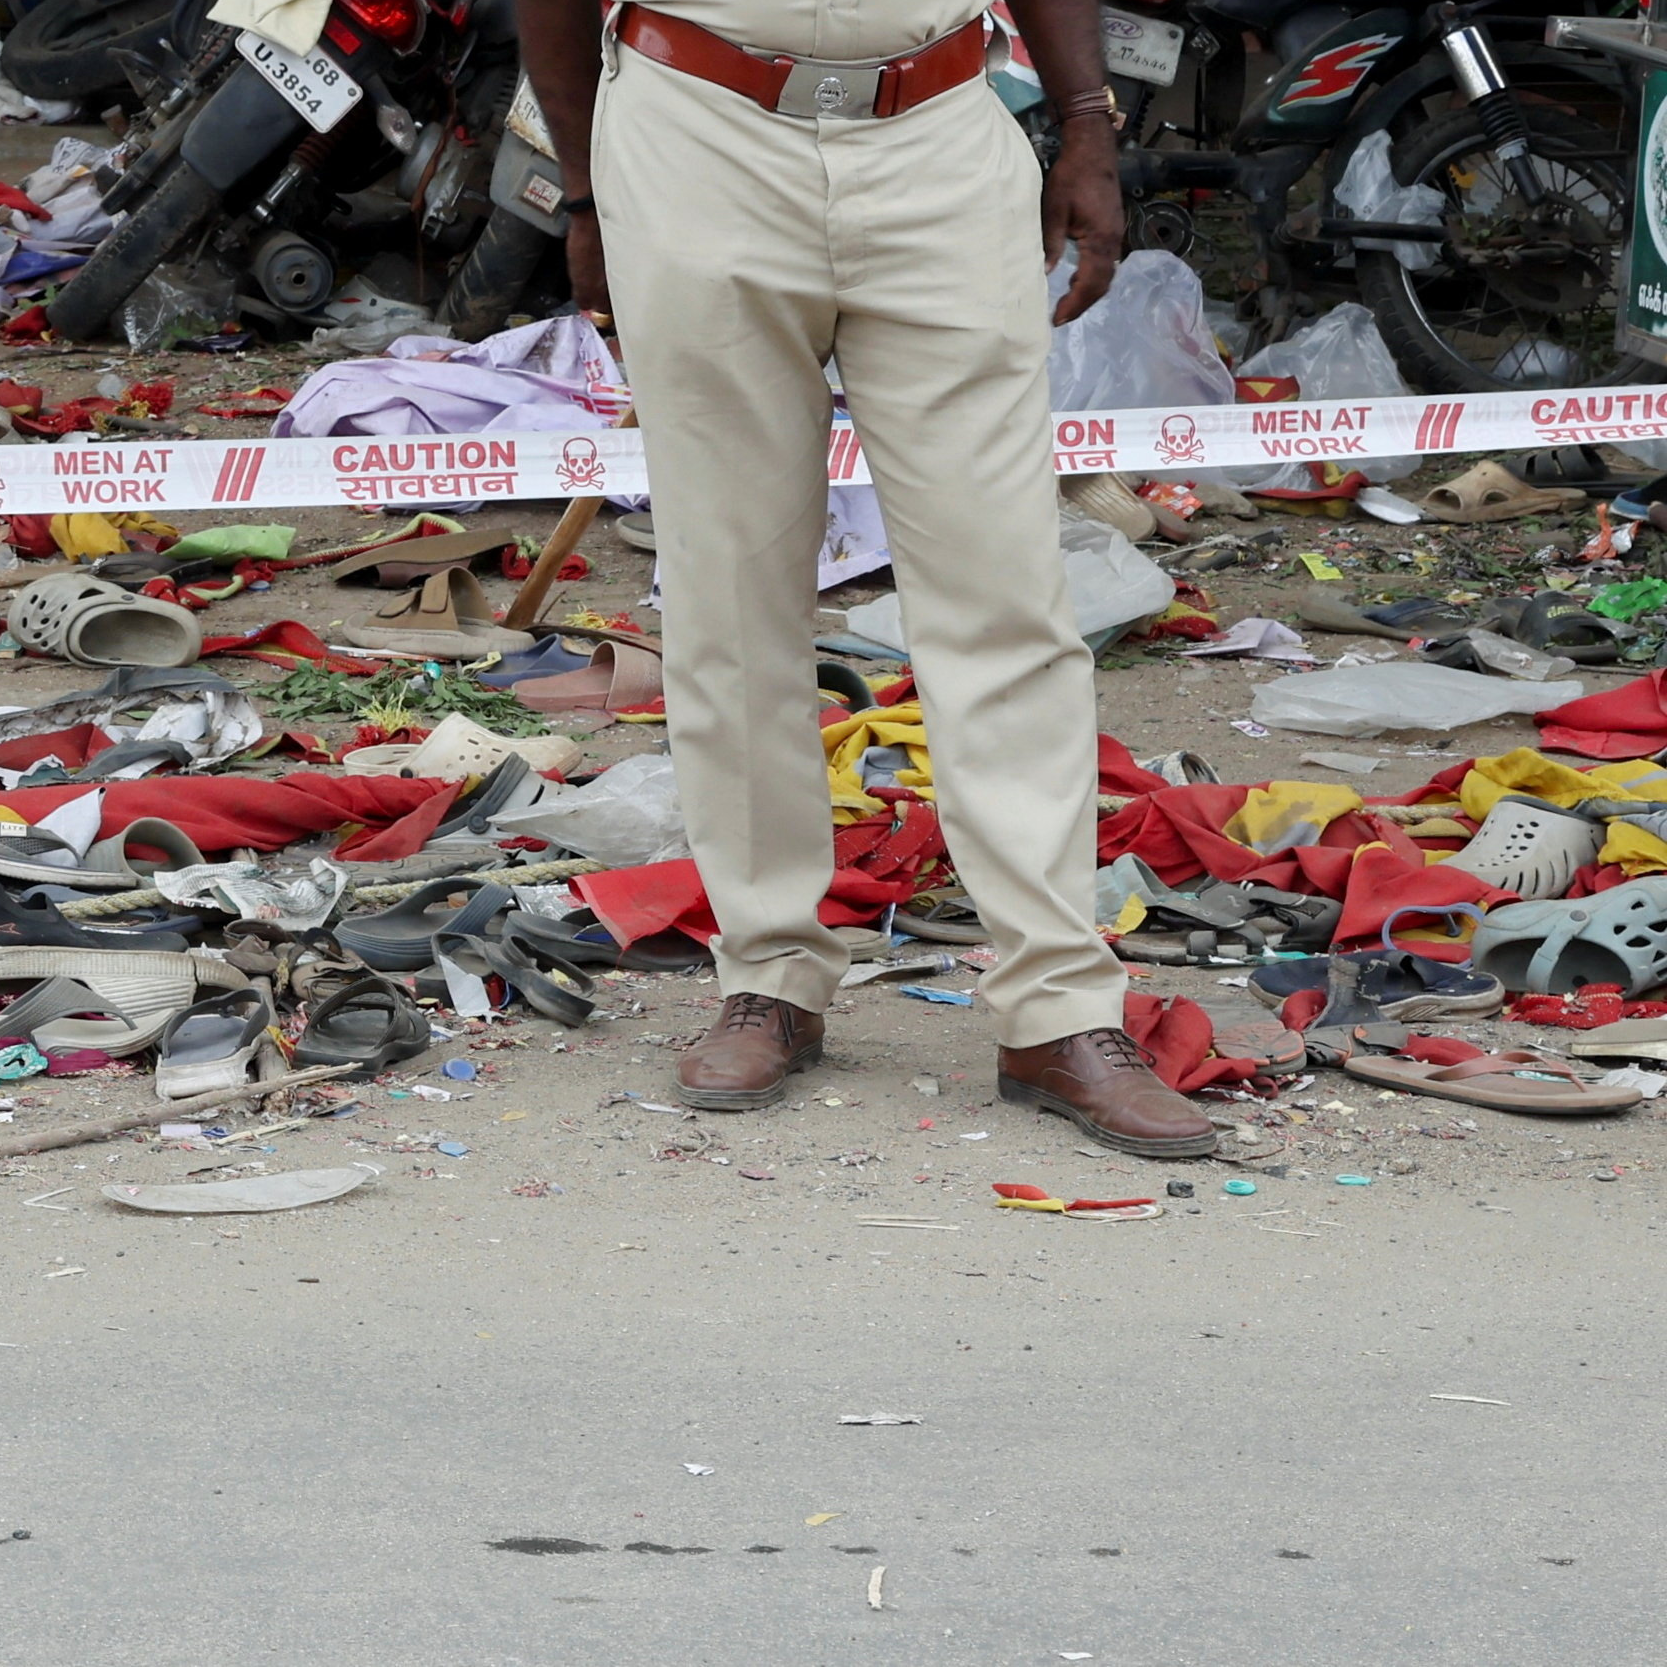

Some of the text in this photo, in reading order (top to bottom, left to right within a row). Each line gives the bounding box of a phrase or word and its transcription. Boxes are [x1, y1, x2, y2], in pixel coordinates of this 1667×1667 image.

[253, 42, 323, 114] U.3854
[1253, 406, 1373, 434] MEN AT
[1531, 394, 1667, 425] CAUTI
[332, 440, 516, 473] CAUTION
[1260, 436, 1367, 457] WORK
[54, 449, 174, 475] MEN AT
[62, 478, 165, 504] WORK
[336, 472, 518, 501] सावधान
